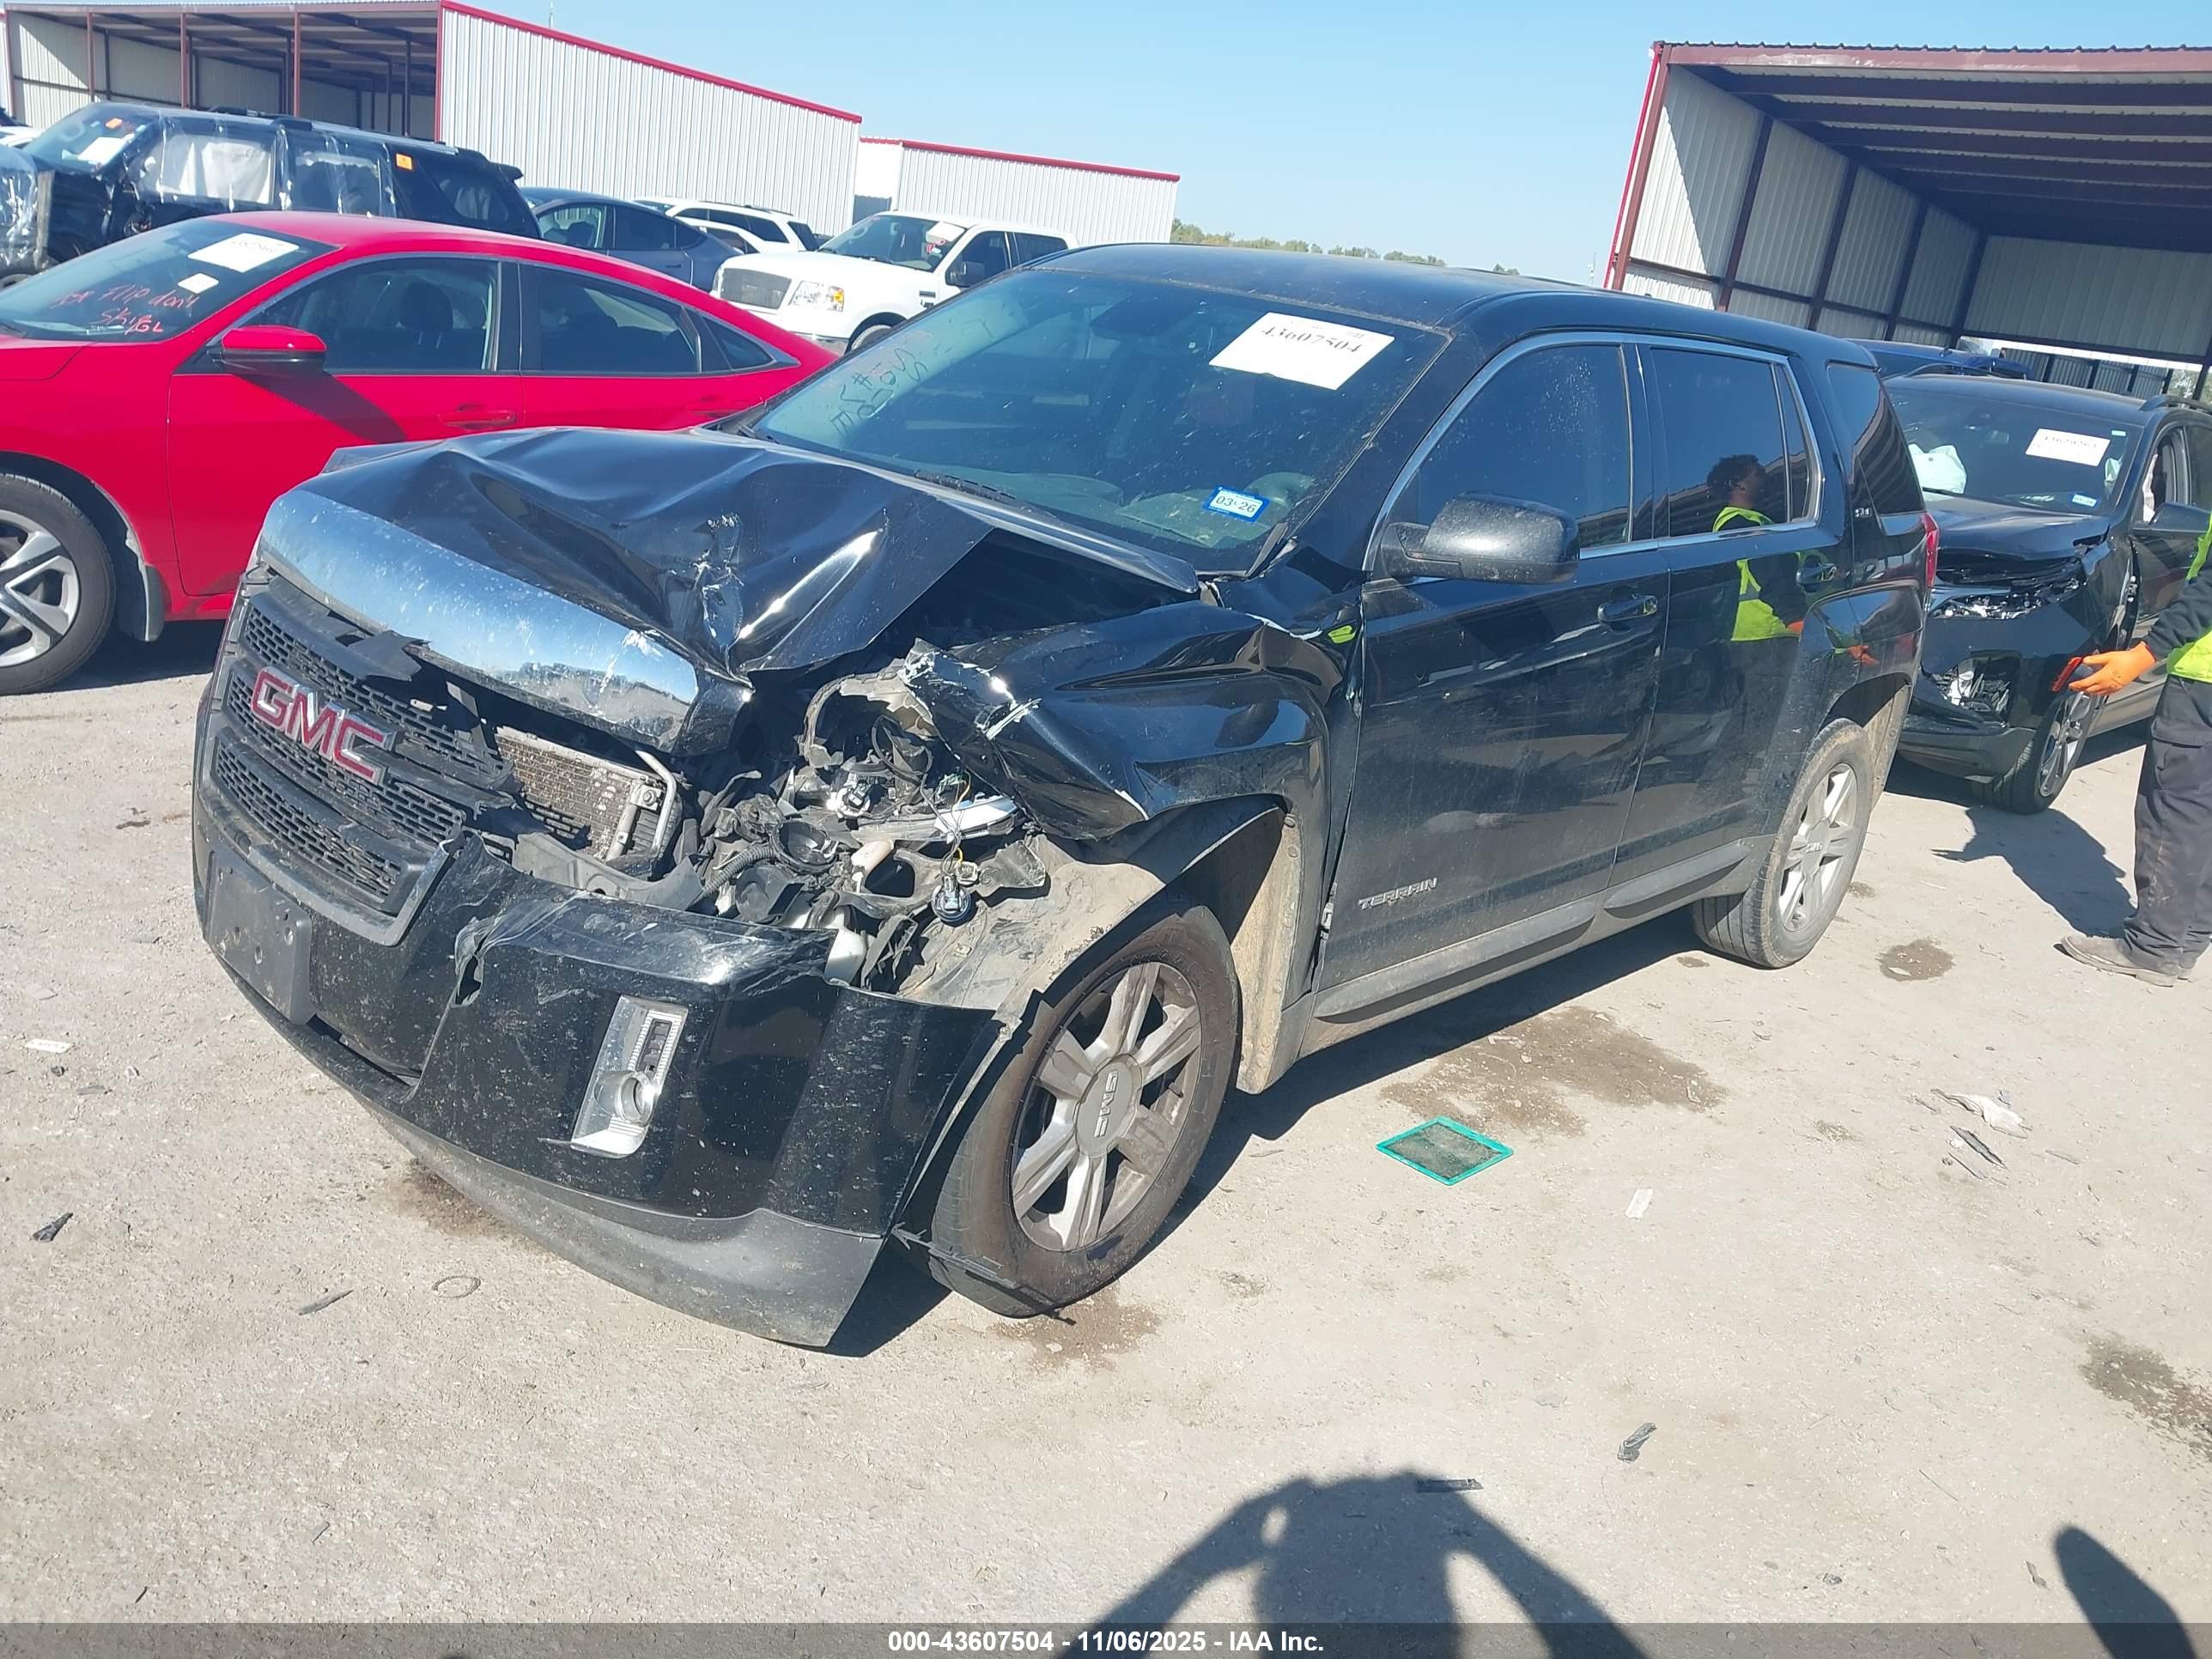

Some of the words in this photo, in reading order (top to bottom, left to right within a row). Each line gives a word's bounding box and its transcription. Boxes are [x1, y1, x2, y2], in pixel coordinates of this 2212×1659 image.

[1261, 325, 1363, 353] 43607504
[251, 665, 397, 786] GMC
[1358, 877, 1437, 910] TERRAIN
[1093, 1070, 1119, 1139] GMC
